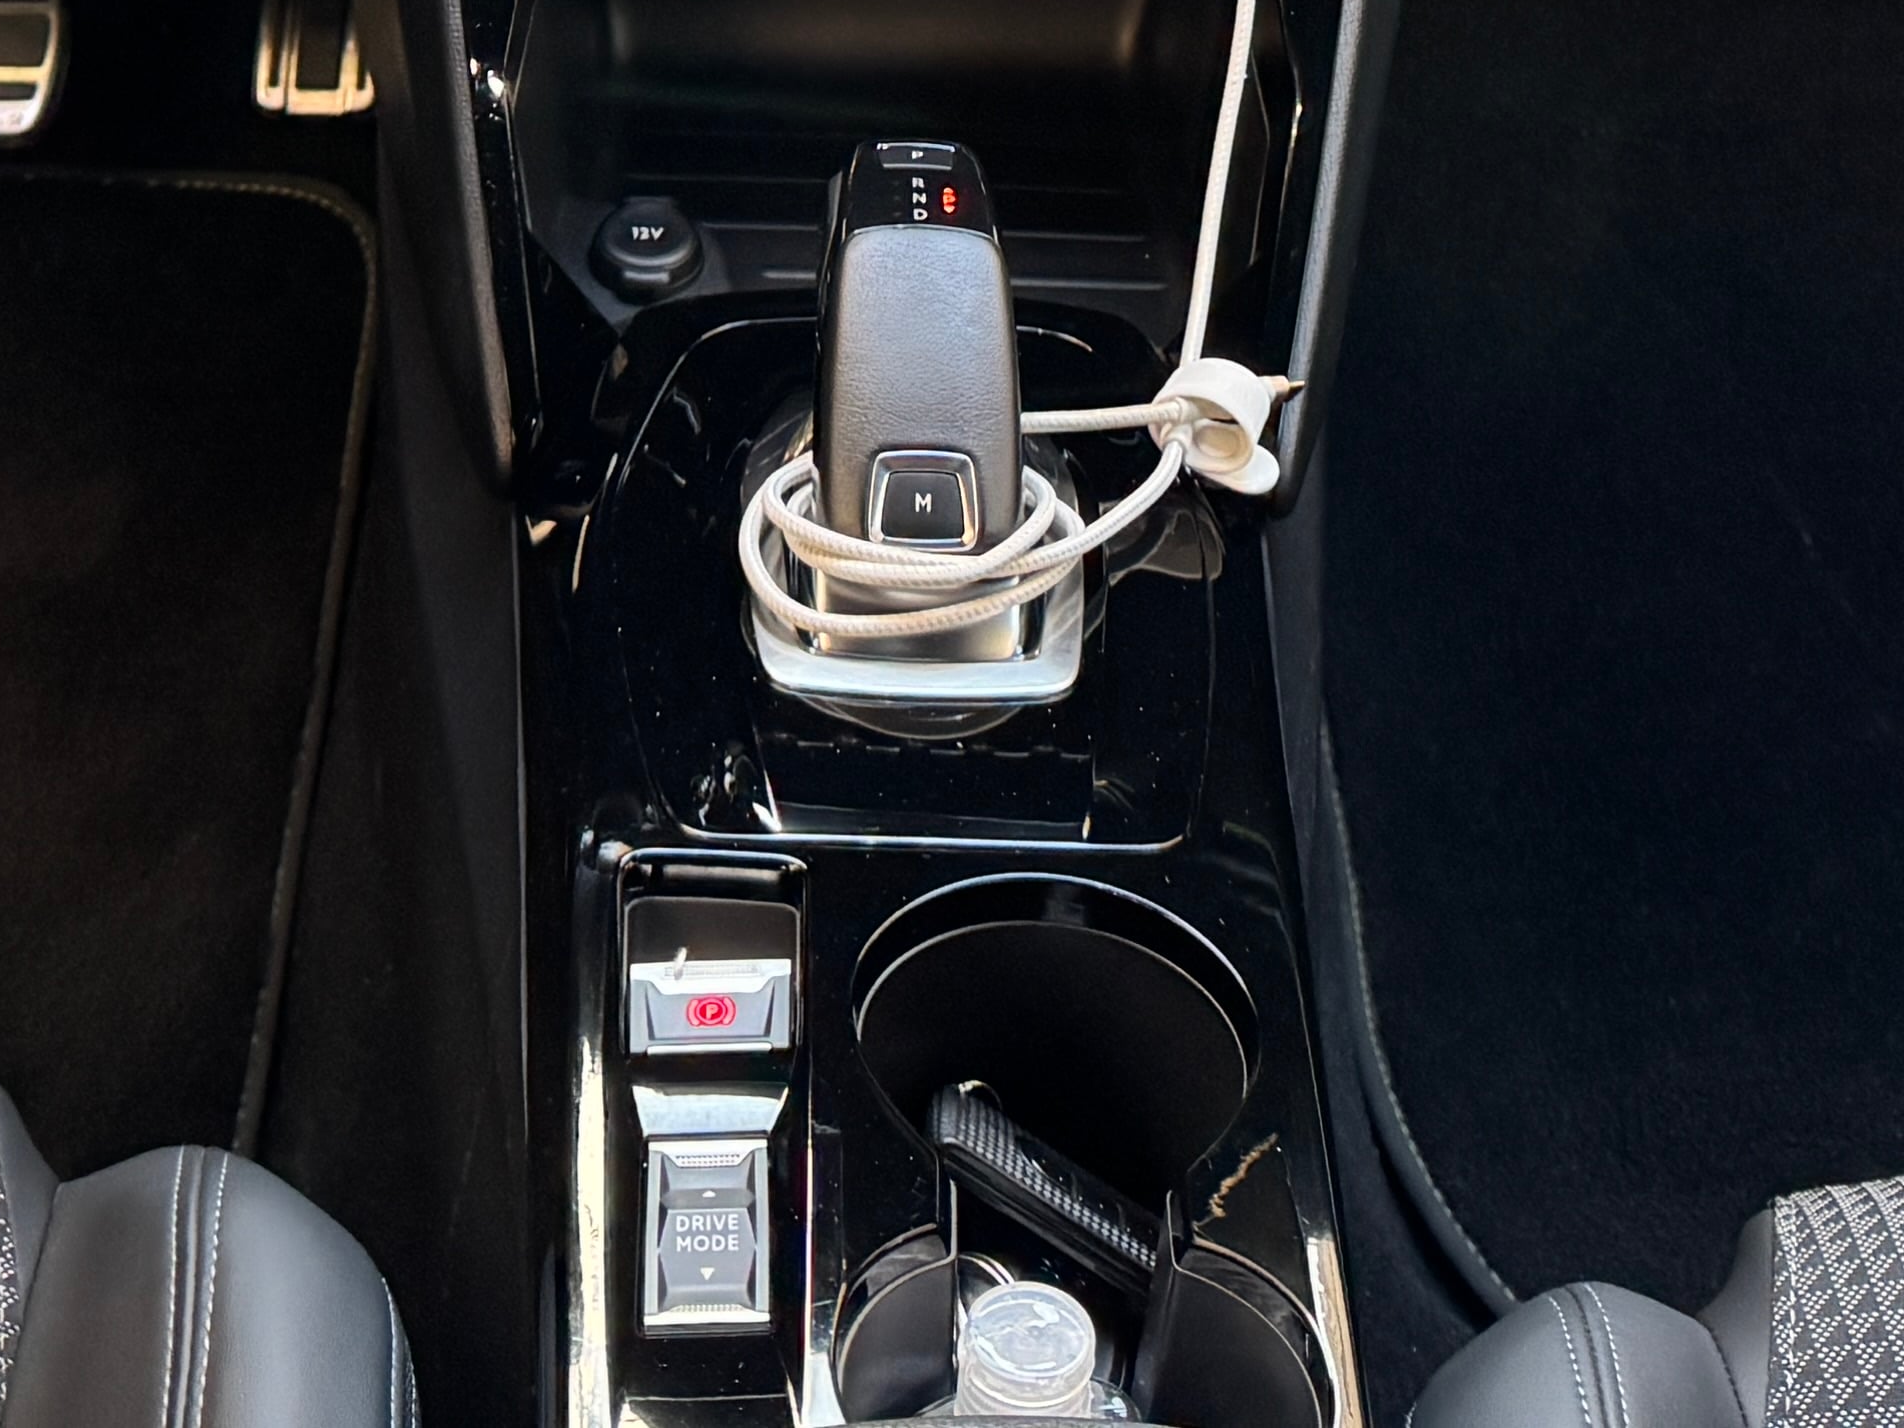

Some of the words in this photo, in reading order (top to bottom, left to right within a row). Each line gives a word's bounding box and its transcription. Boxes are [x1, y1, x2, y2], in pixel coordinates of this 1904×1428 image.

[911, 150, 924, 160] P
[912, 192, 927, 204] N
[913, 208, 928, 221] D
[631, 226, 664, 241] 12V
[915, 492, 933, 513] M
[675, 1213, 739, 1233] DRIVE
[675, 1233, 739, 1252] MODE
